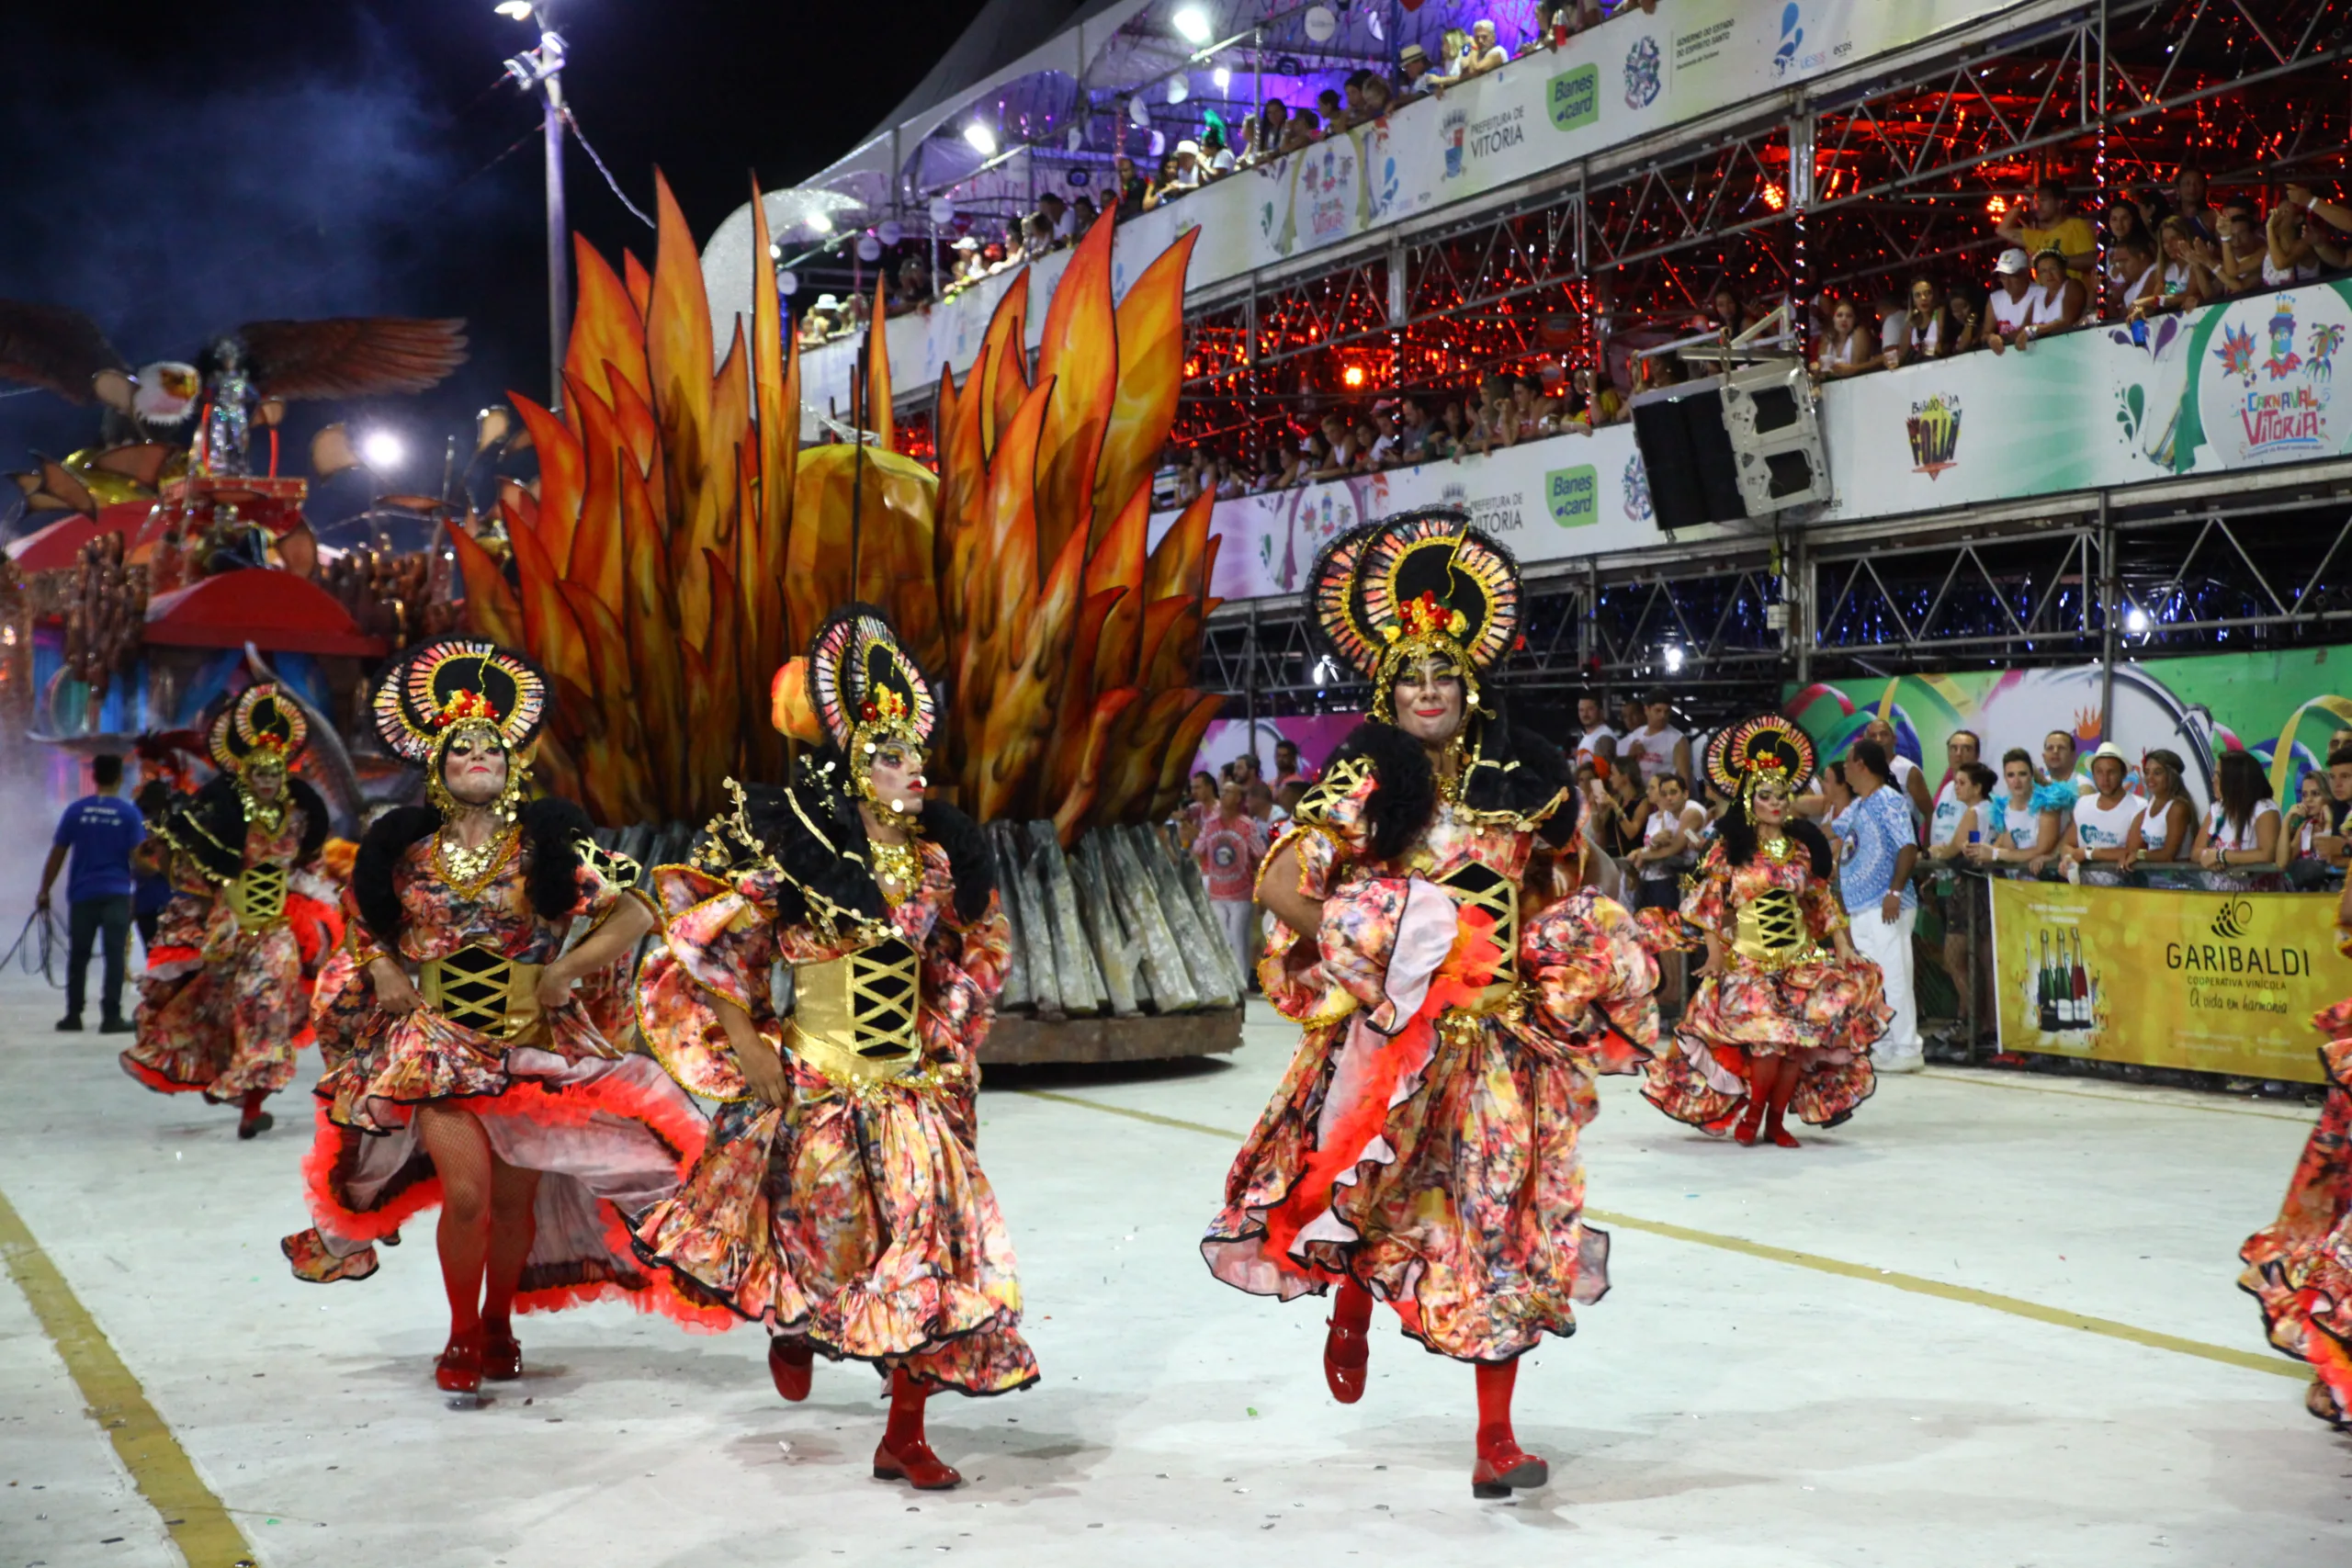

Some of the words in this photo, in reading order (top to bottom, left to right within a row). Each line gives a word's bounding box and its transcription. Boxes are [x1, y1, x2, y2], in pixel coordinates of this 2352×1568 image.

[1554, 73, 1594, 103] Banes
[1565, 90, 1594, 120] card
[1470, 110, 1512, 137] PREFEITURA
[1513, 105, 1524, 120] DE
[2247, 384, 2319, 412] CARNAVAL
[1512, 491, 1523, 505] DE
[1553, 474, 1593, 497] Banes
[1564, 493, 1593, 516] card
[2165, 942, 2311, 977] GARIBALDI
[2187, 975, 2243, 988] COOPERATIVA
[2245, 977, 2287, 991] VINÍCOLA
[2189, 987, 2200, 1009] A
[2203, 994, 2223, 1010] vida
[2226, 998, 2239, 1010] em
[2243, 993, 2289, 1015] harmonia
